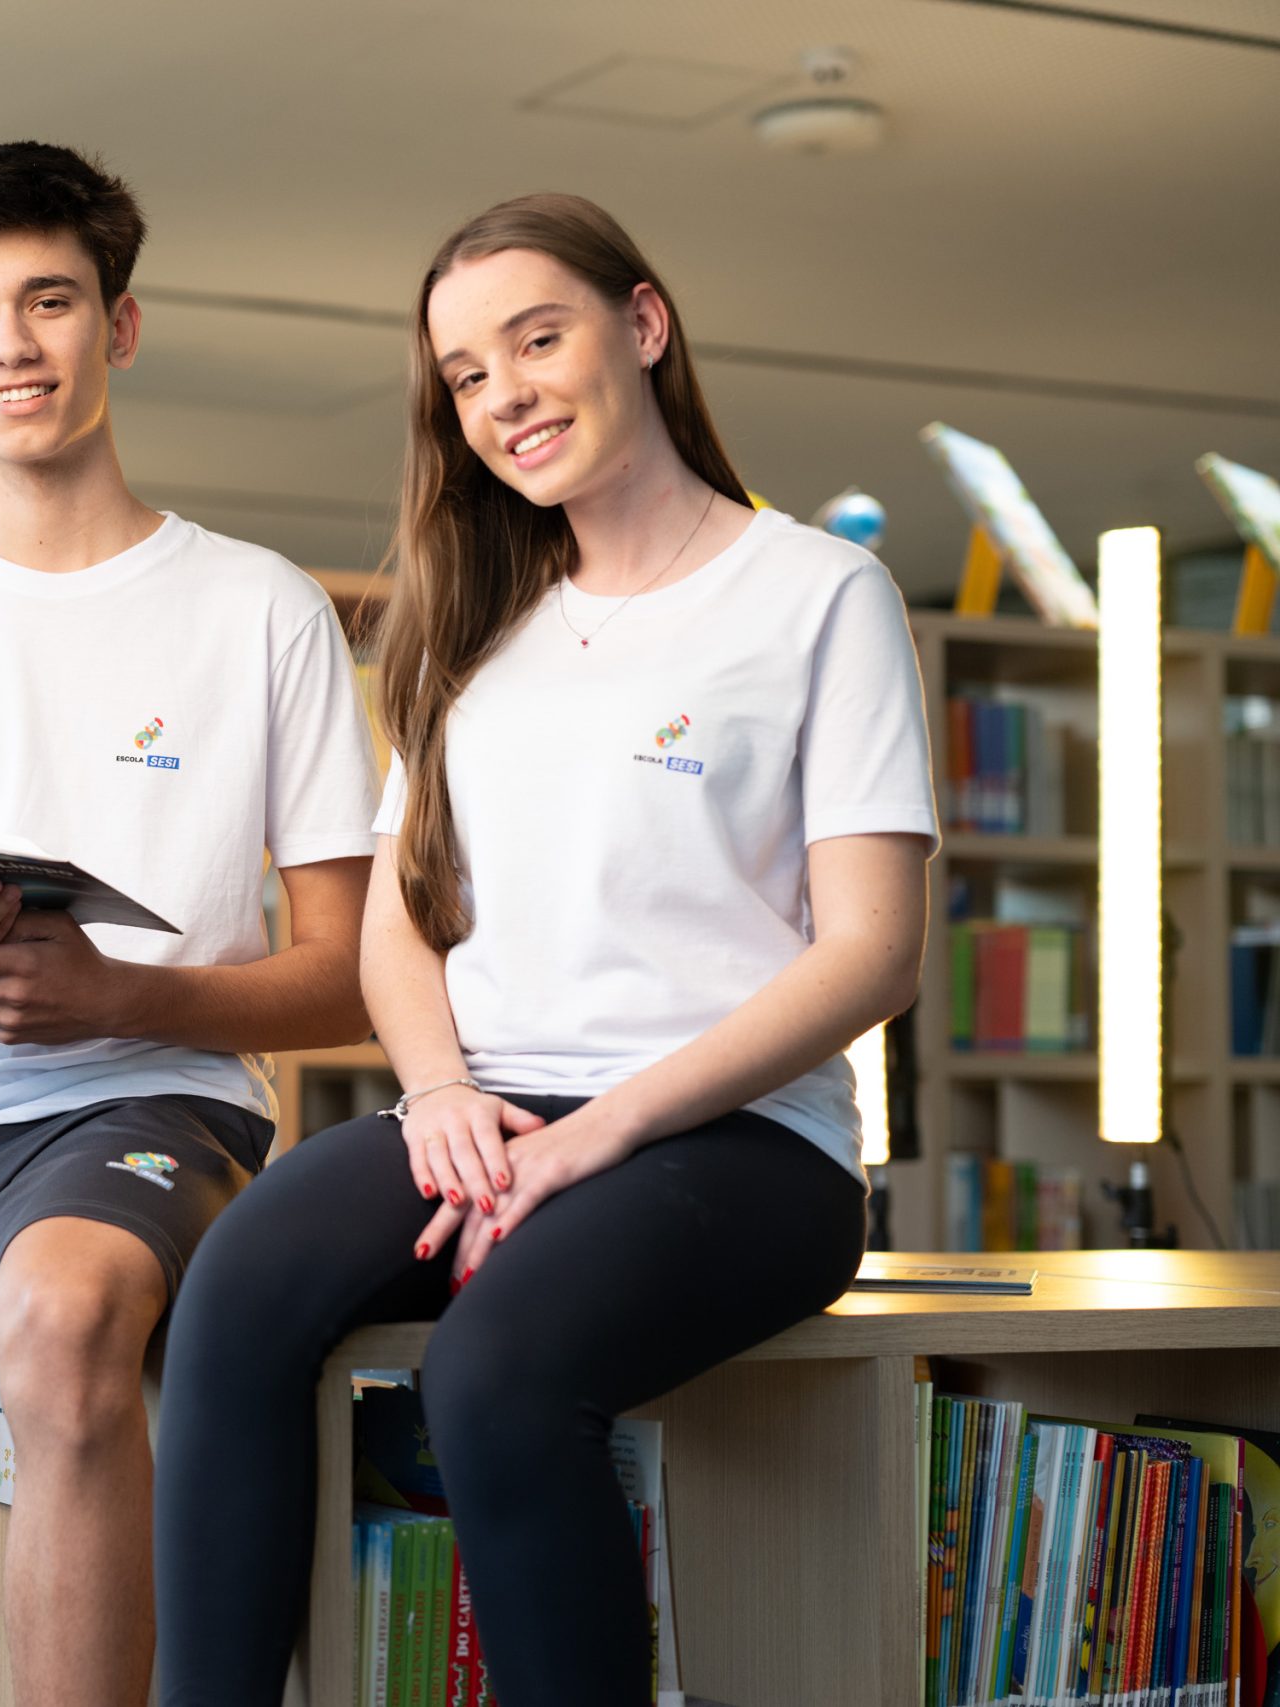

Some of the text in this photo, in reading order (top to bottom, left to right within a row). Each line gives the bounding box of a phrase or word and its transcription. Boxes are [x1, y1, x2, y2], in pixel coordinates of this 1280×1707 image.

[116, 755, 177, 768] ESCOLA SESI
[668, 757, 702, 773] SESI
[455, 1632, 470, 1657] DO
